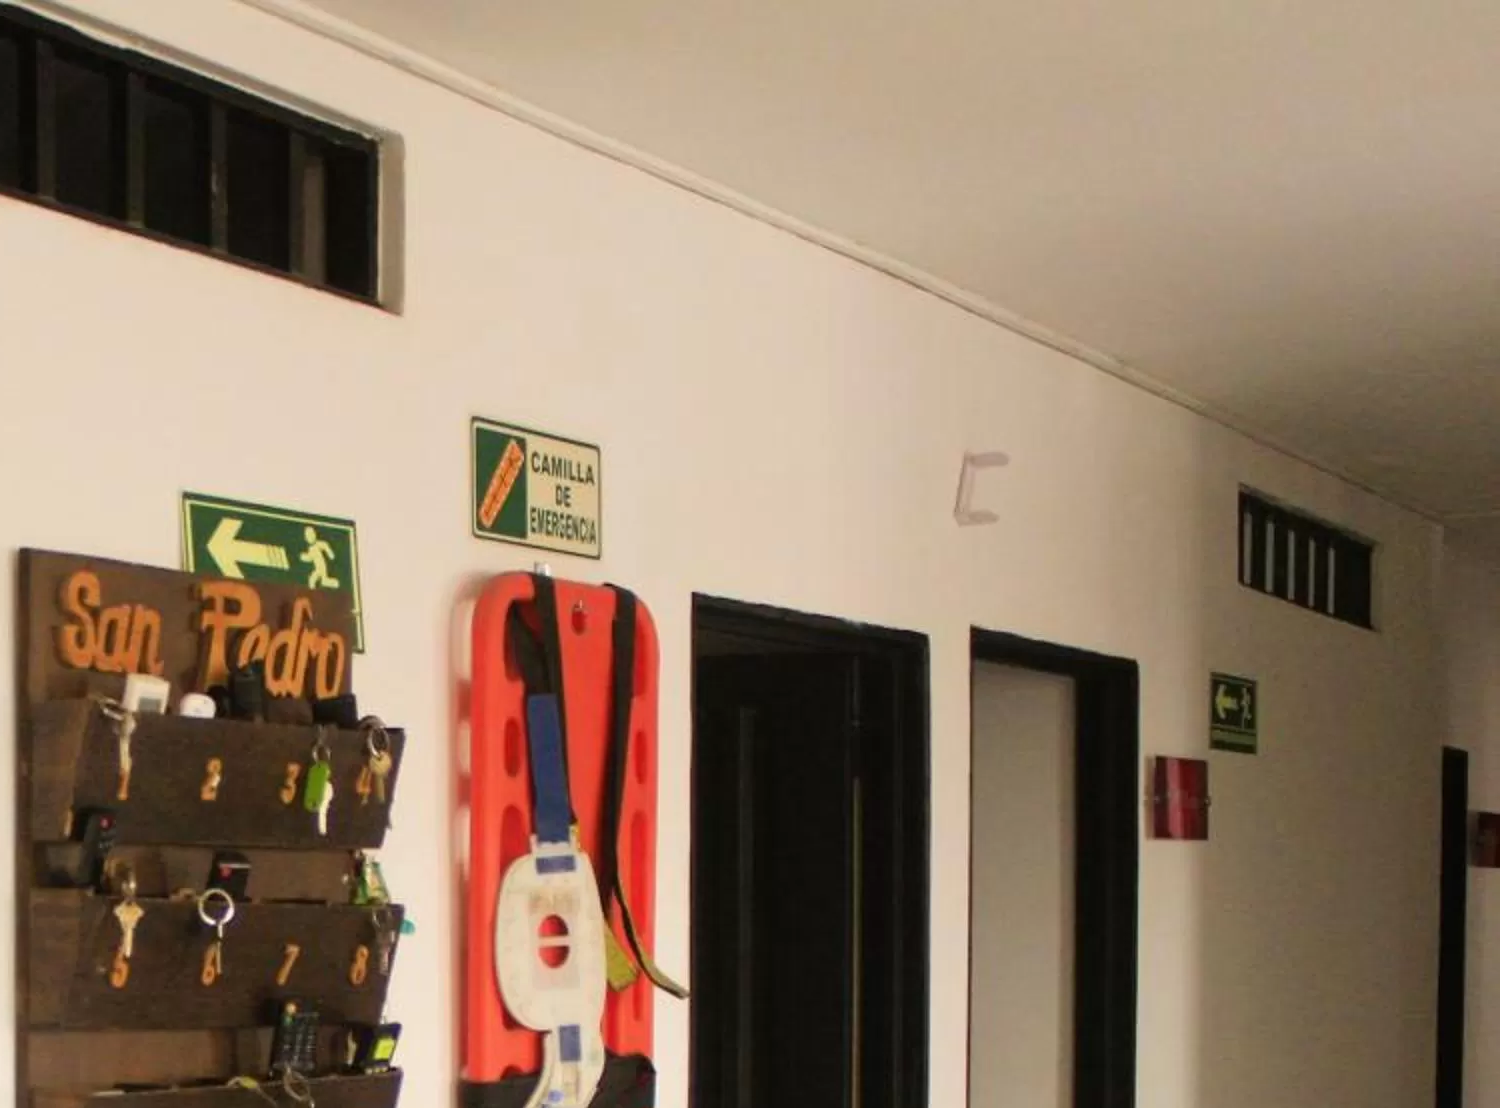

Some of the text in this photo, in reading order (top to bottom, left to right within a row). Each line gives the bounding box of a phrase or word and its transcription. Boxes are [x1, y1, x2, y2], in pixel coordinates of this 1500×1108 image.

[530, 450, 596, 486] CAMILLA
[555, 484, 572, 508] DE
[530, 507, 597, 545] EMERGENCIA
[62, 571, 164, 676] San
[280, 761, 301, 805] 3
[277, 944, 300, 986] 7
[349, 945, 371, 986] 8
